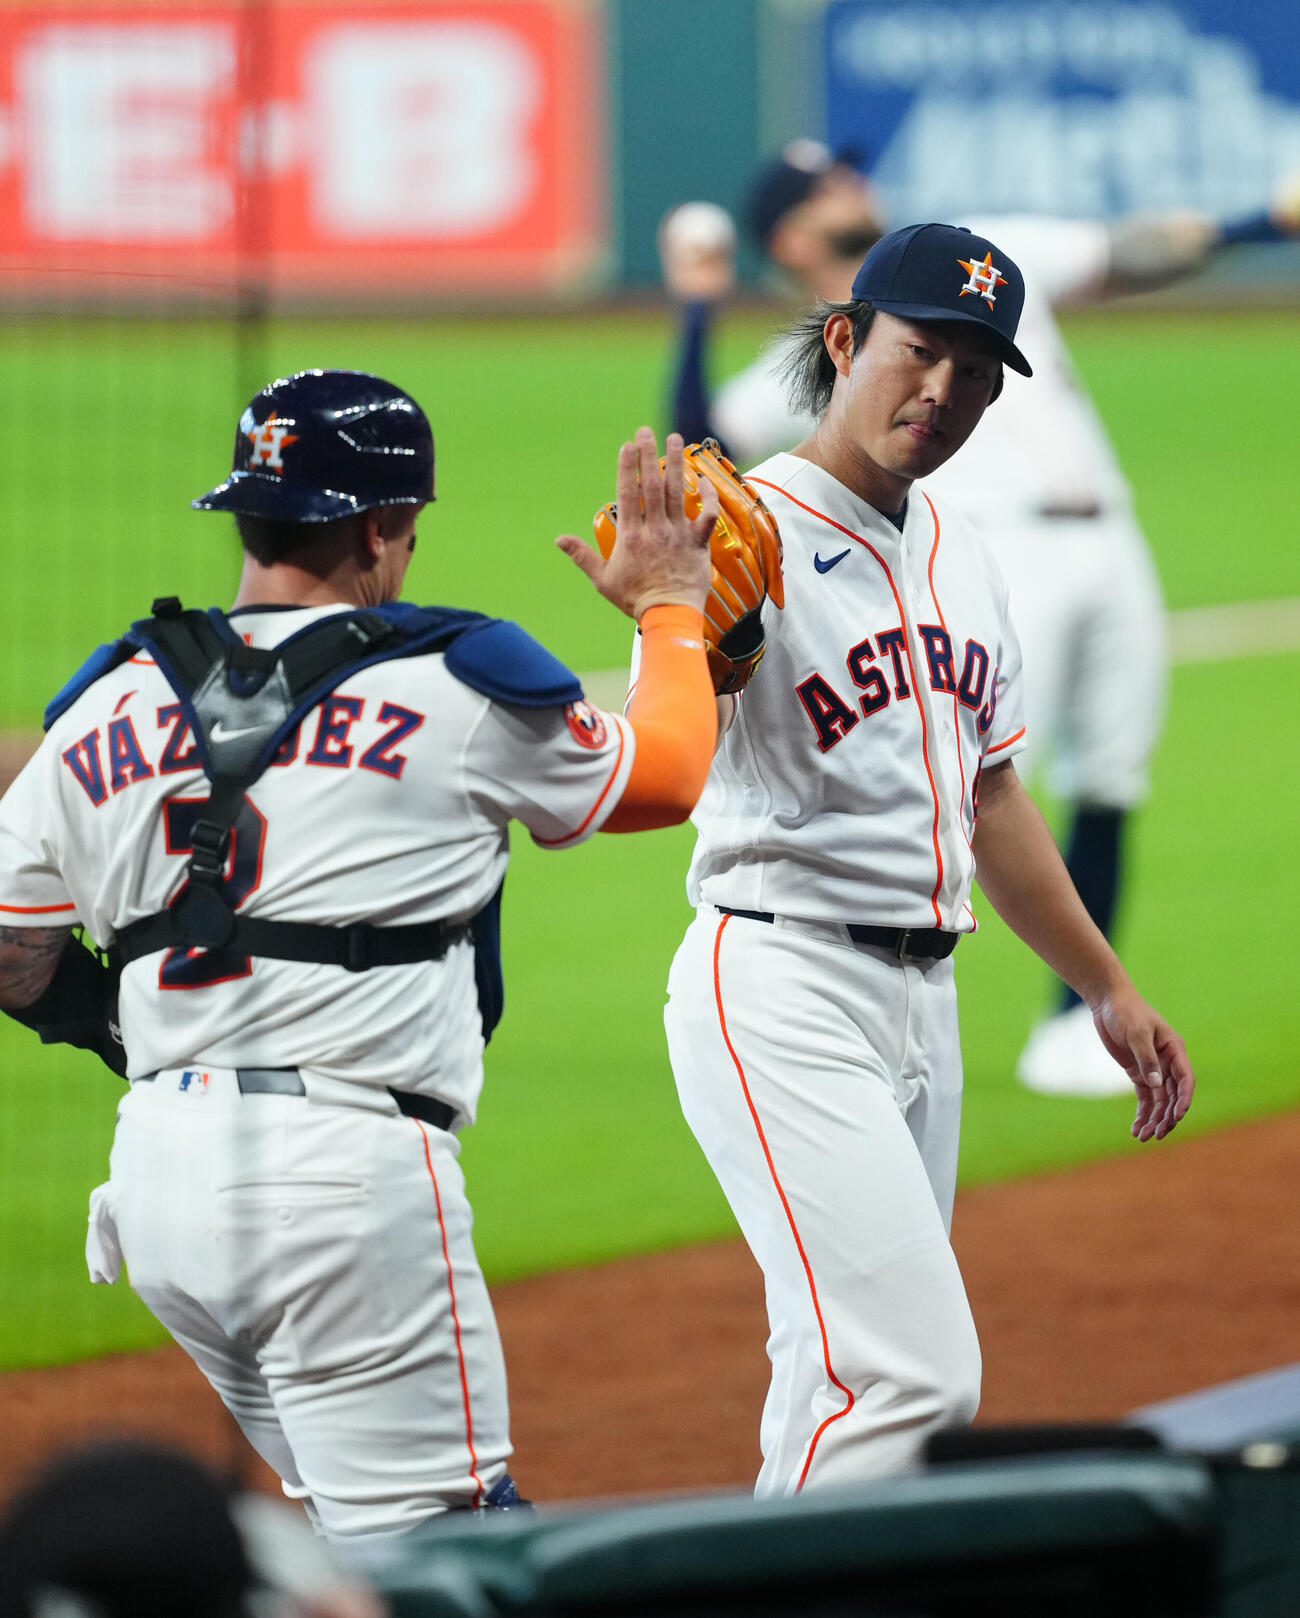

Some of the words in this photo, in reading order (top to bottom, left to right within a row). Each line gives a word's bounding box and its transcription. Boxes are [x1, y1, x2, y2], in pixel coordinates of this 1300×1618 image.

[0, 18, 545, 243] E-B
[962, 258, 1002, 301] H
[250, 426, 288, 467] H
[62, 690, 425, 807] VÁZEZ
